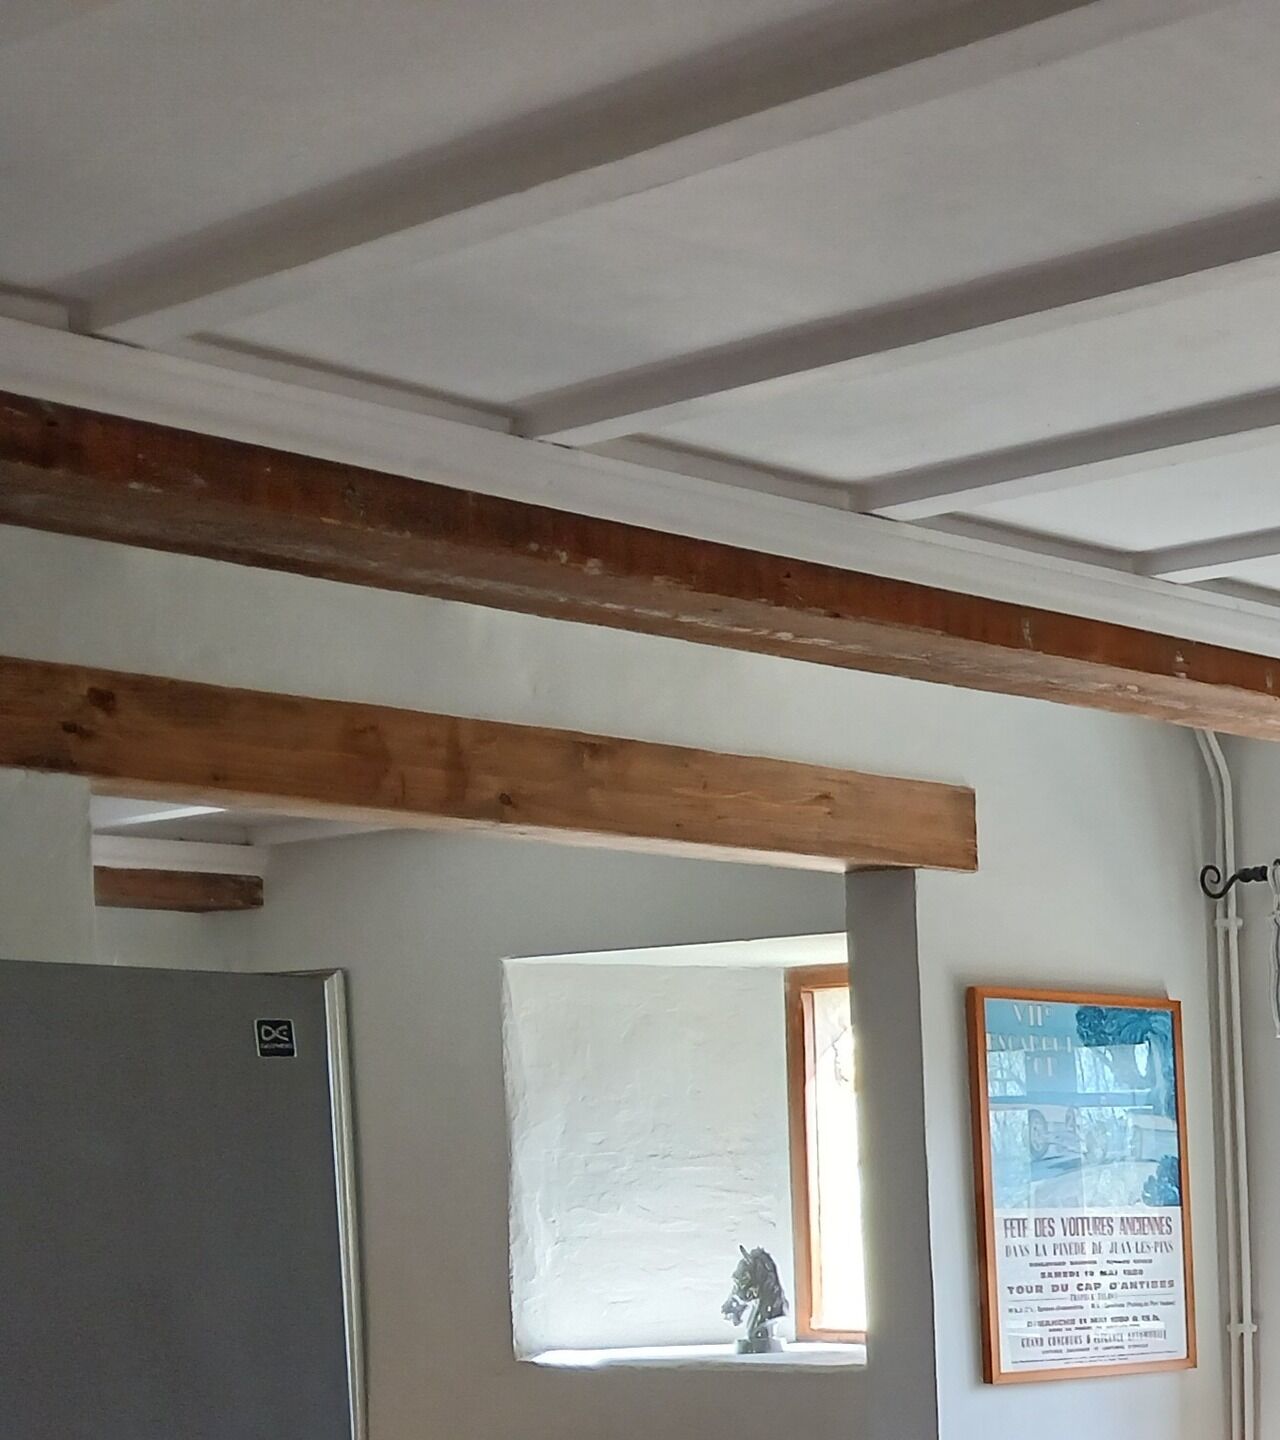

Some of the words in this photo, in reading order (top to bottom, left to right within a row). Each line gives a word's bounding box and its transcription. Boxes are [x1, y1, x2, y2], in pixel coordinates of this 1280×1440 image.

[1034, 1217, 1055, 1238] DES
[1061, 1216, 1114, 1237] VOITURES
[1119, 1216, 1173, 1236] ANCIENNES
[1035, 1243, 1047, 1257] LA
[1092, 1241, 1102, 1255] DE
[1007, 1285, 1044, 1295] TOUR
[1051, 1283, 1069, 1293] DU
[1076, 1282, 1102, 1292] CAP
